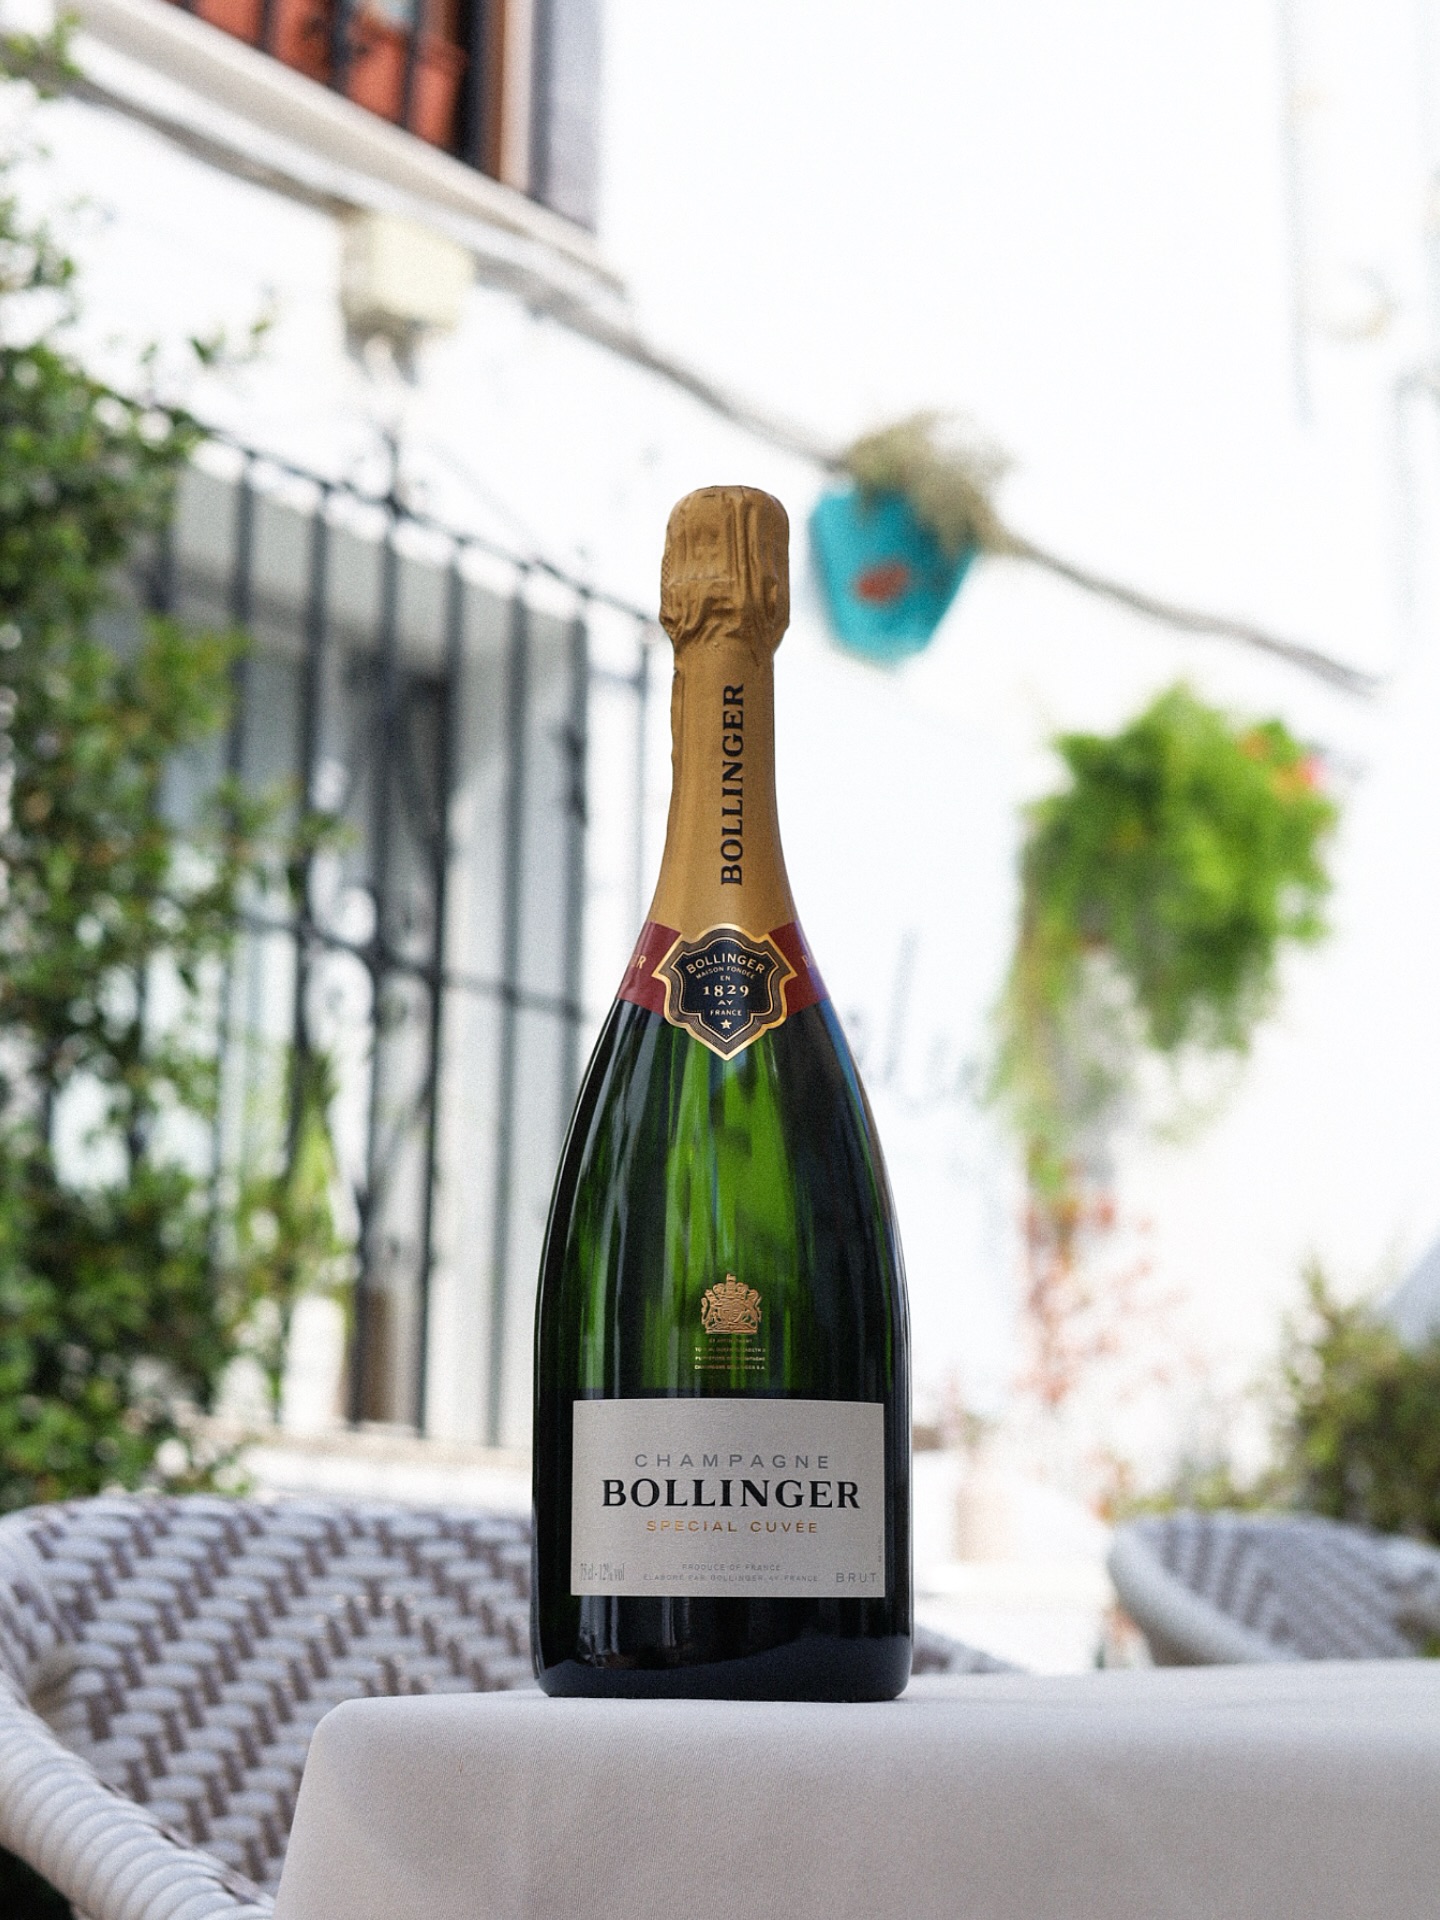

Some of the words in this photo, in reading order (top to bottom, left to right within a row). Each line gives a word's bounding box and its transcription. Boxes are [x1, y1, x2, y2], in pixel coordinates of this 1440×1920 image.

[720, 684, 744, 886] BOLLINGER
[686, 953, 766, 974] BOLLINGER
[695, 966, 724, 979] MAISON
[703, 984, 749, 998] 1829
[634, 1453, 829, 1469] CHAMPAGNE
[602, 1478, 860, 1509] BOLLINGER
[646, 1520, 737, 1532] SPECIAL
[750, 1519, 818, 1534] CUVÉE
[681, 1563, 725, 1571] PRODUCE
[729, 1563, 741, 1571] OF
[745, 1563, 780, 1571] FRANCE
[836, 1572, 876, 1583] BRUT
